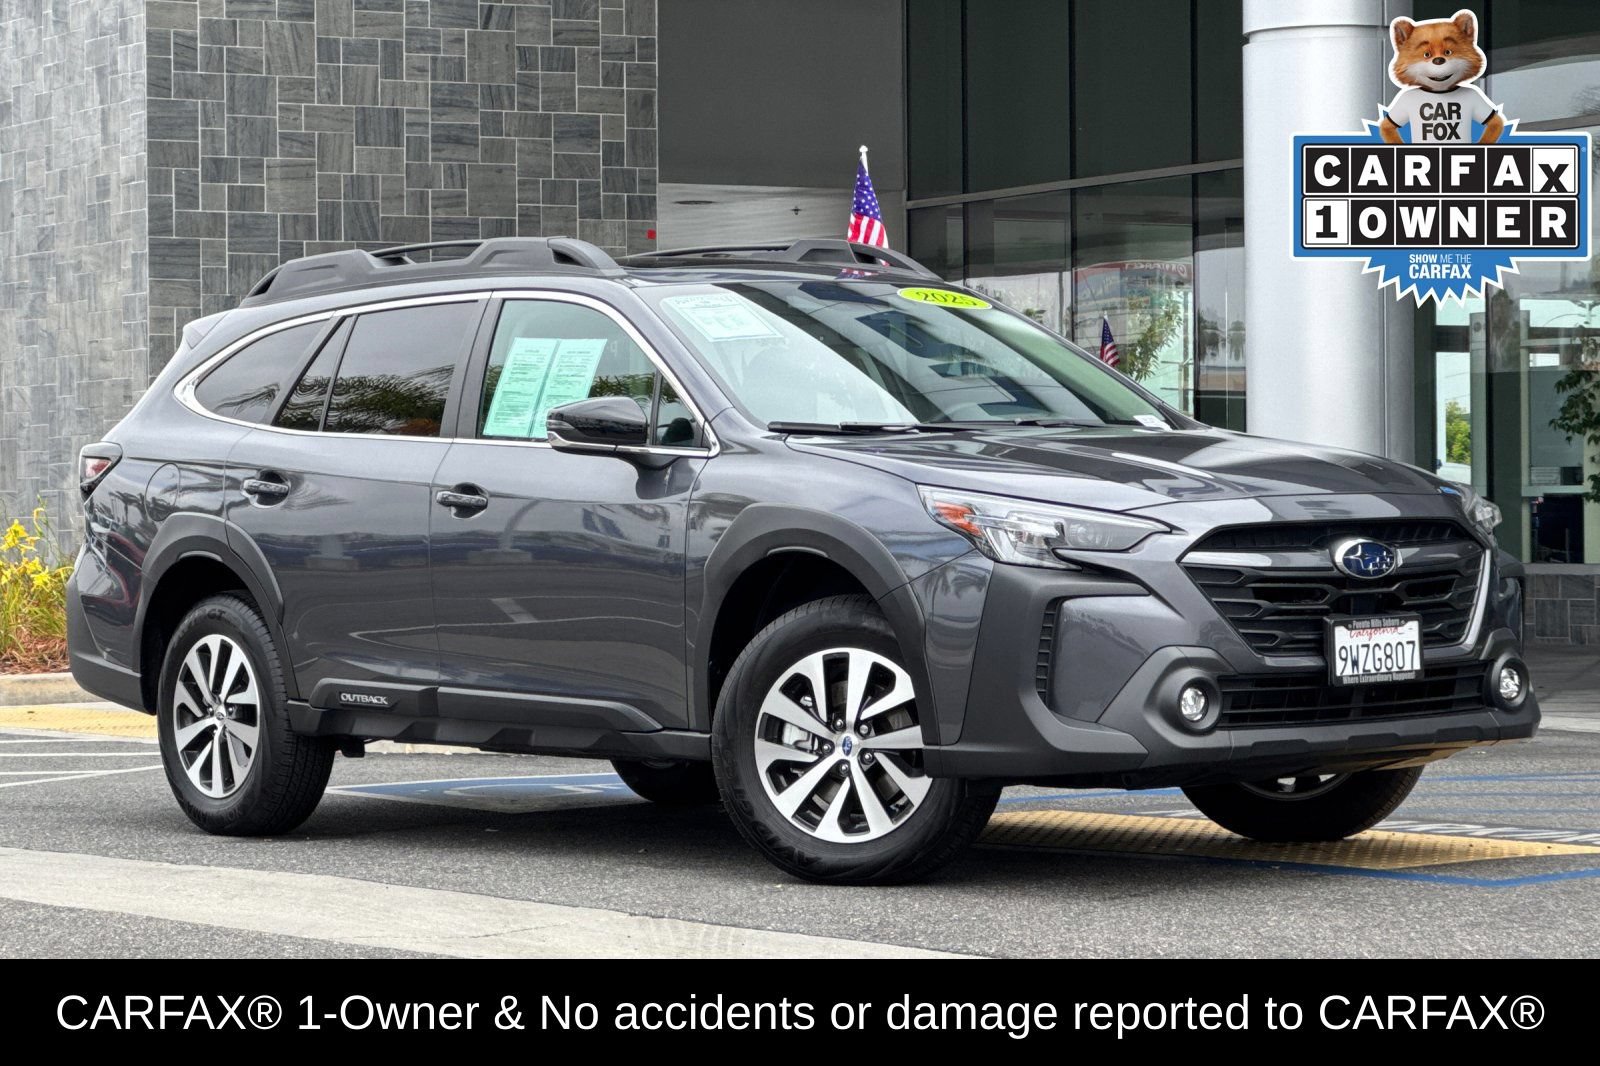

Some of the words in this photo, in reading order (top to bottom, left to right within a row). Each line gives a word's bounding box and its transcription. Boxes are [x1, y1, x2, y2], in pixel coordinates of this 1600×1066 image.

[916, 291, 978, 307] 2025
[1338, 640, 1416, 676] 9WZG807
[340, 692, 389, 705] OUTBACK
